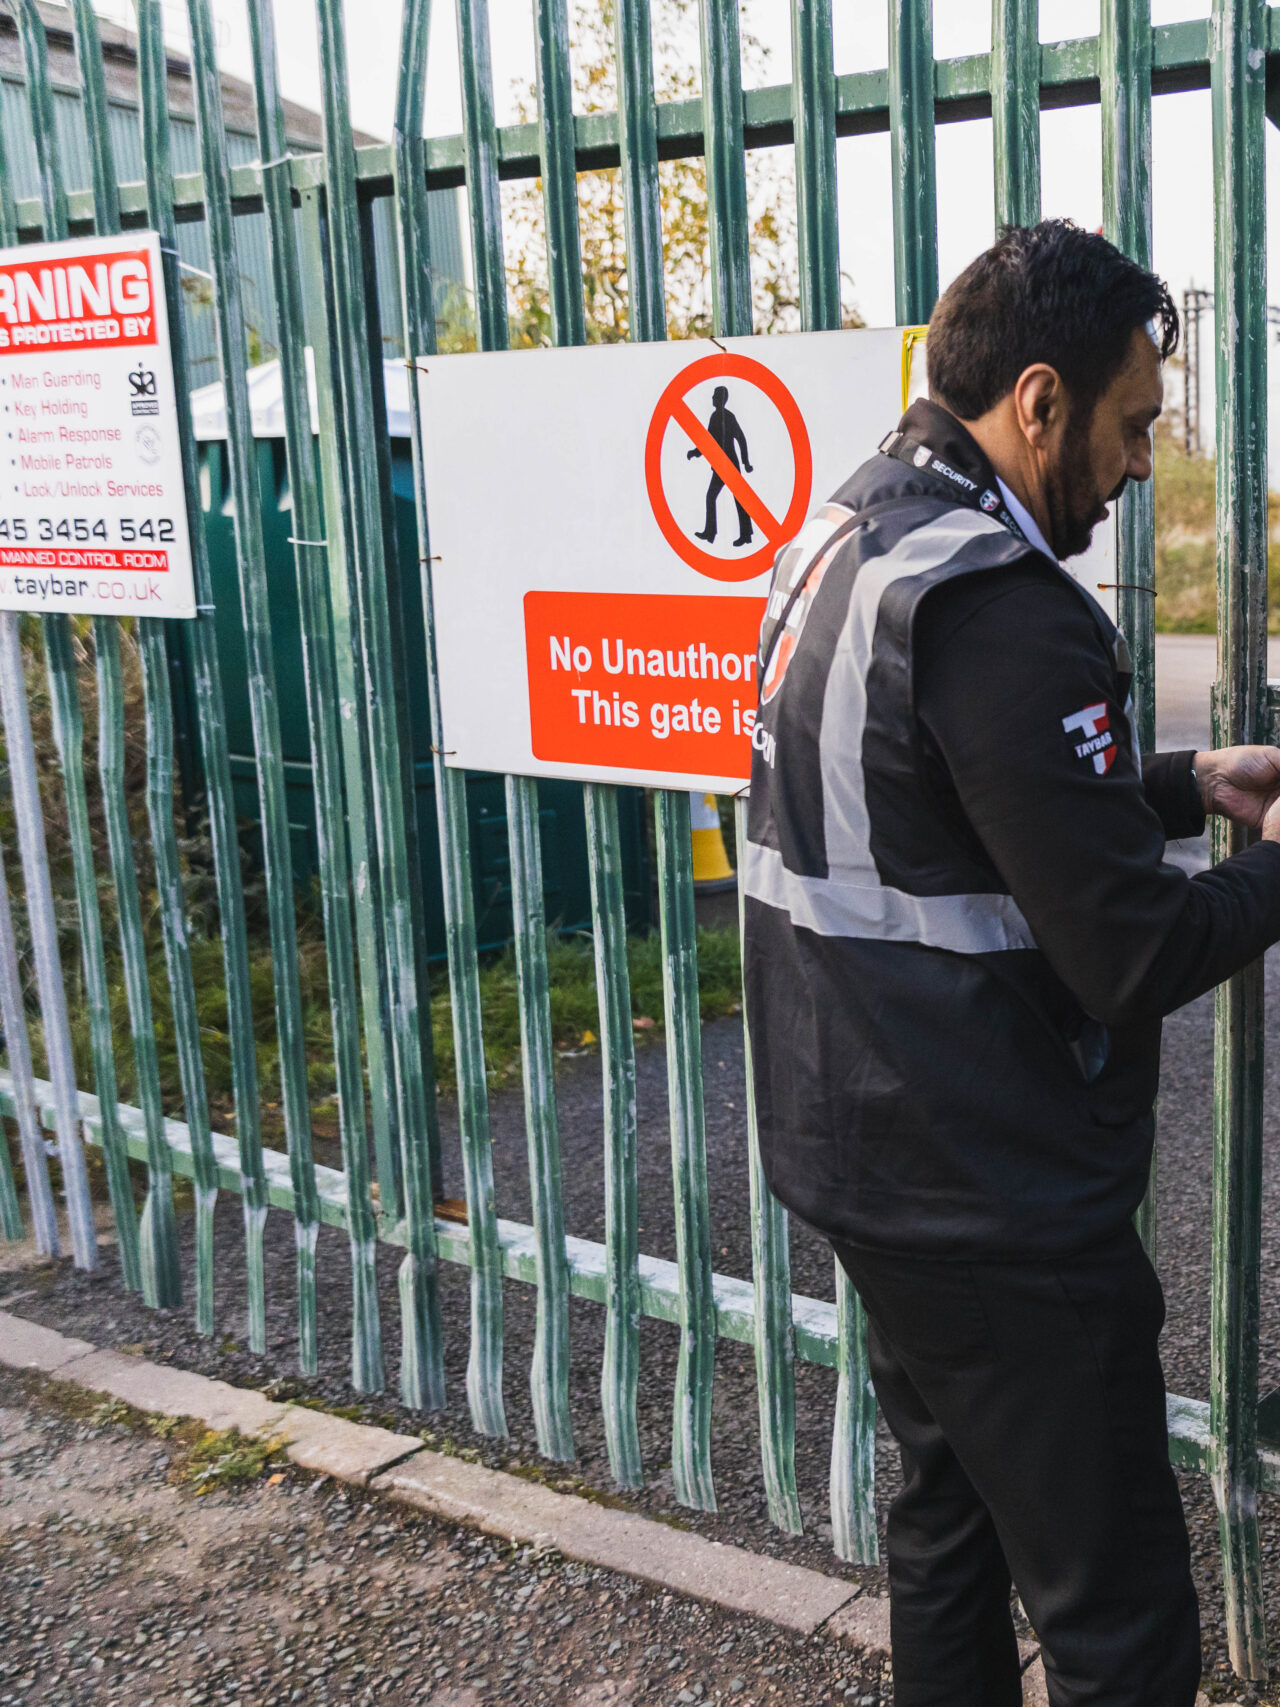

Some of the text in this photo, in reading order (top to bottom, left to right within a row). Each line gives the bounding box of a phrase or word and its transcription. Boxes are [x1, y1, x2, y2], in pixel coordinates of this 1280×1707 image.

[12, 319, 120, 345] PROTECTED
[123, 316, 151, 337] BY
[11, 371, 101, 390] Man Guarding
[14, 399, 88, 419] Key Holding
[18, 426, 121, 444] Alarm Response
[20, 453, 112, 471] Mobile Patrols
[931, 459, 978, 491] SECURITY
[24, 480, 163, 497] Lock/Unlock Services
[38, 518, 108, 542] 3454
[119, 518, 176, 543] 542
[1, 551, 167, 568] MANNED CONTROL ROOM
[549, 635, 757, 682] No Unauthor
[571, 688, 758, 739] This gate is
[1074, 731, 1113, 758] TAYBAR
